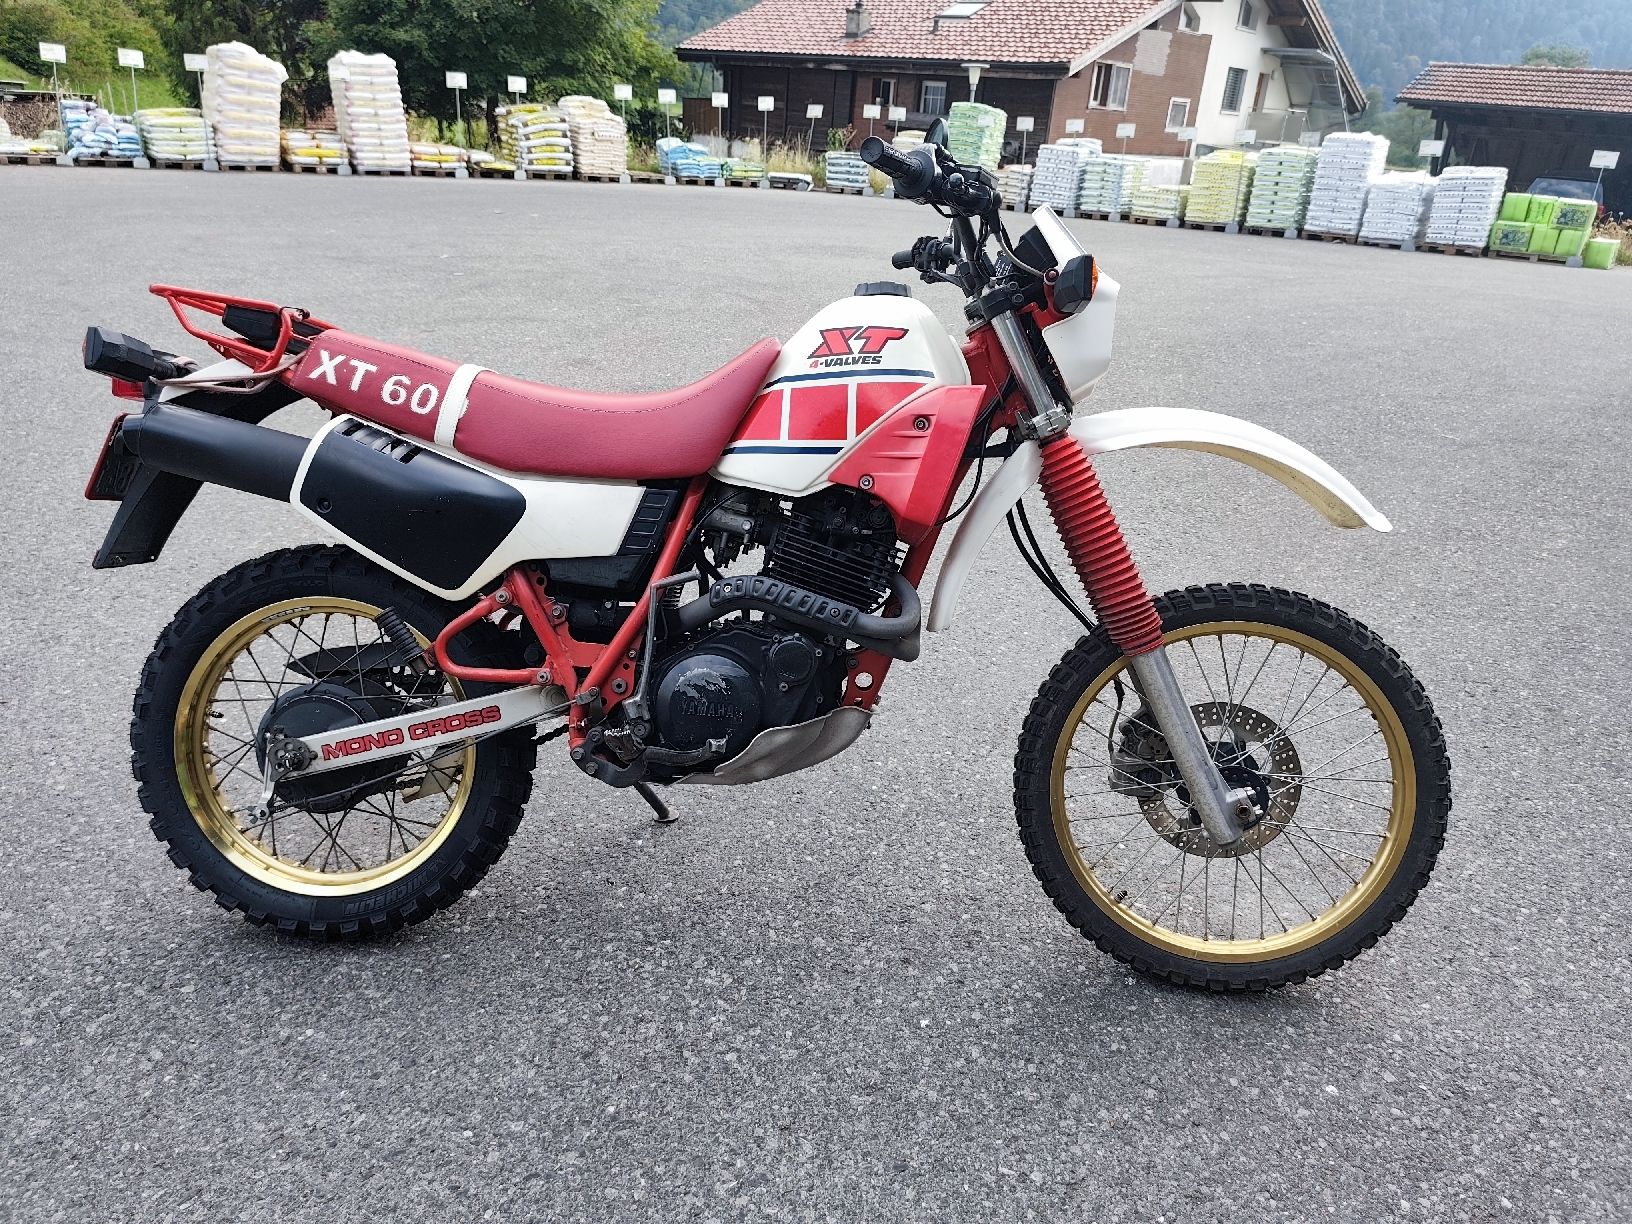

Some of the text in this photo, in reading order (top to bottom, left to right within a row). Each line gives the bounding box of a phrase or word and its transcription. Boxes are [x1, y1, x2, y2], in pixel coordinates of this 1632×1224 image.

[807, 326, 909, 359] XT
[809, 355, 883, 369] 4-VALVES
[308, 349, 470, 418] XT 60
[680, 699, 735, 717] YAMAHA
[321, 705, 502, 761] MONO CROSS
[344, 873, 428, 915] MICHELIN
